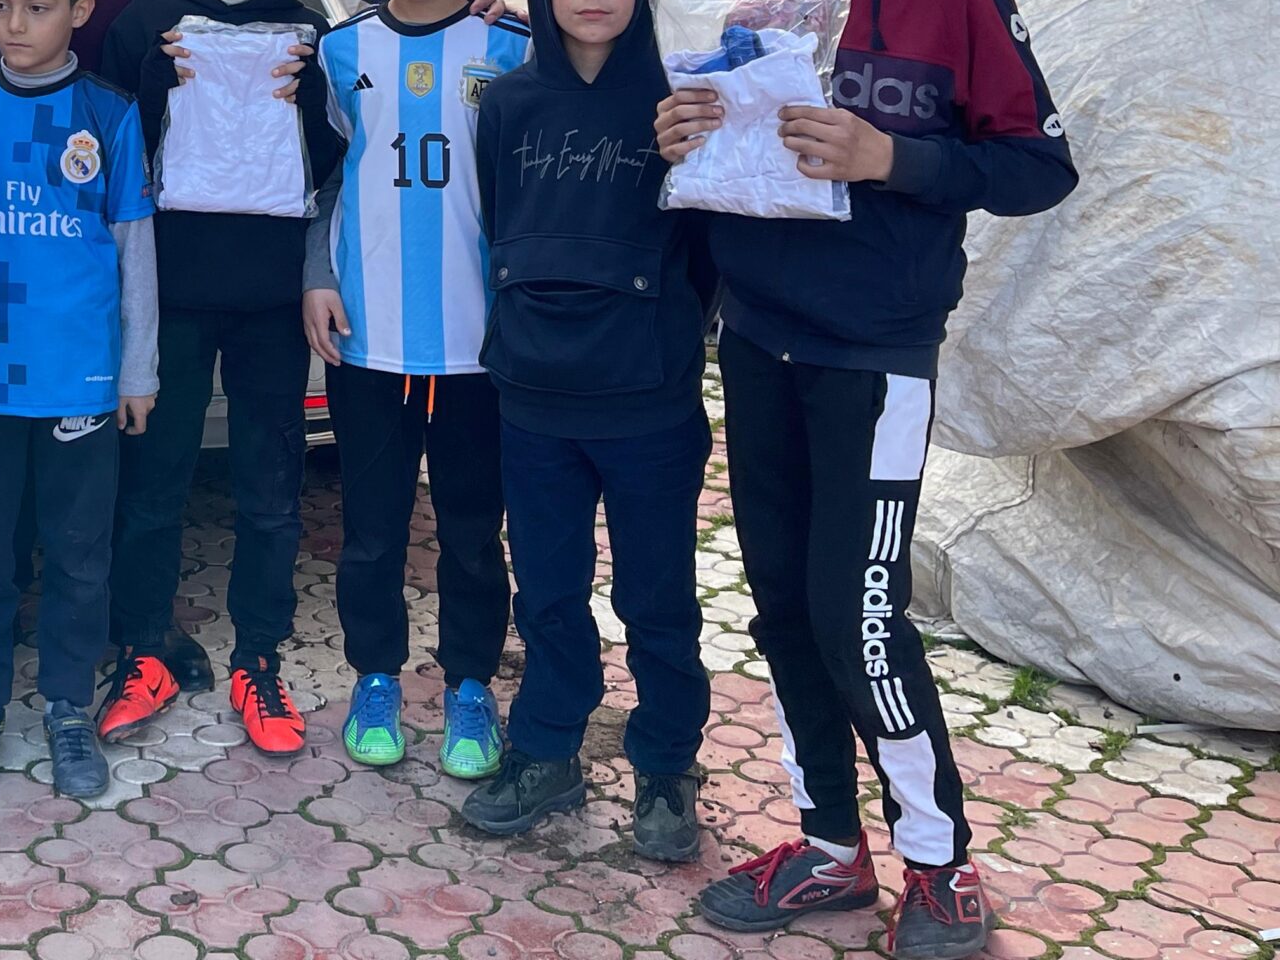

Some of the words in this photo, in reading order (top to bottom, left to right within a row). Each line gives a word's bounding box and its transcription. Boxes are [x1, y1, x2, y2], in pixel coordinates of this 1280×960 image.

[831, 62, 939, 120] das
[391, 132, 451, 189] 10
[6, 180, 41, 206] Fly
[60, 415, 96, 431] NIKE
[861, 564, 894, 679] adidas
